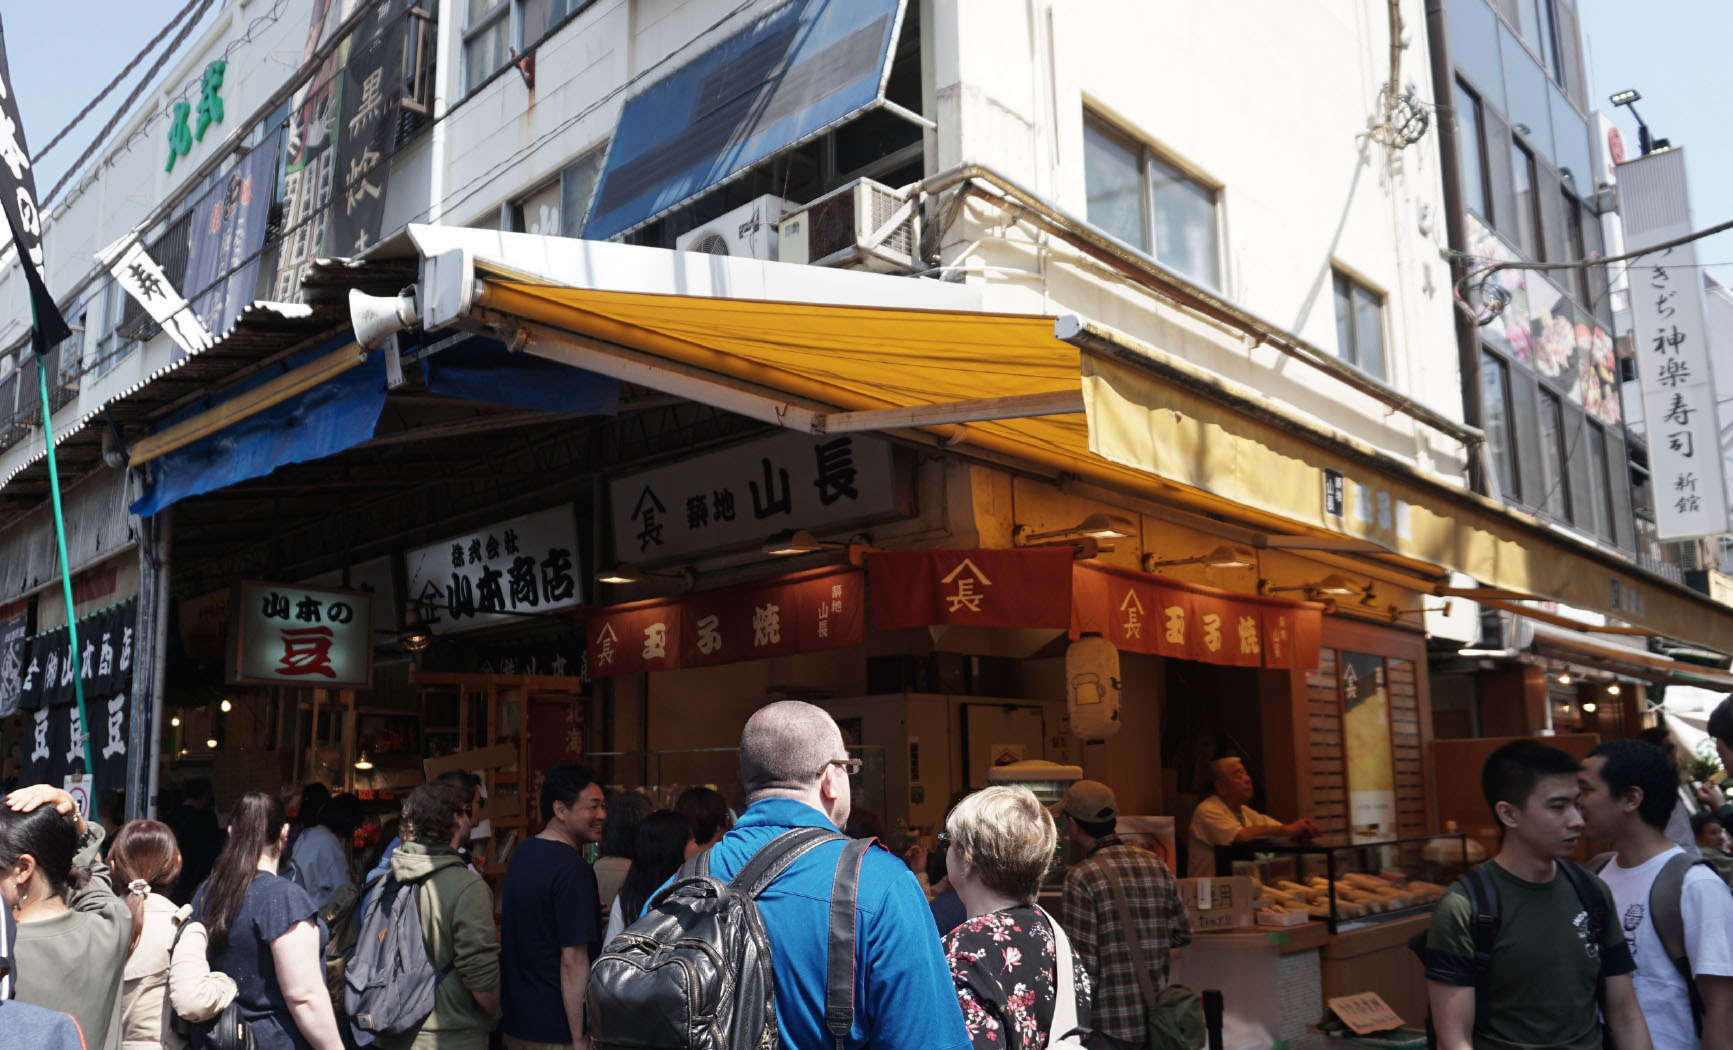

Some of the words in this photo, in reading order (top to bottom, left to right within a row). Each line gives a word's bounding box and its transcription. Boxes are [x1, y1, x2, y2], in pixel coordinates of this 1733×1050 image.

[686, 487, 736, 531] 築地
[749, 436, 858, 520] 山長
[1674, 471, 1702, 514] 新館
[450, 529, 520, 568] 株式会社
[446, 547, 577, 620] 山本商店
[262, 591, 354, 625] 山本の
[816, 601, 829, 639] 山長
[274, 625, 338, 679] 豆
[31, 708, 50, 764] 豆
[102, 692, 126, 760] 豆
